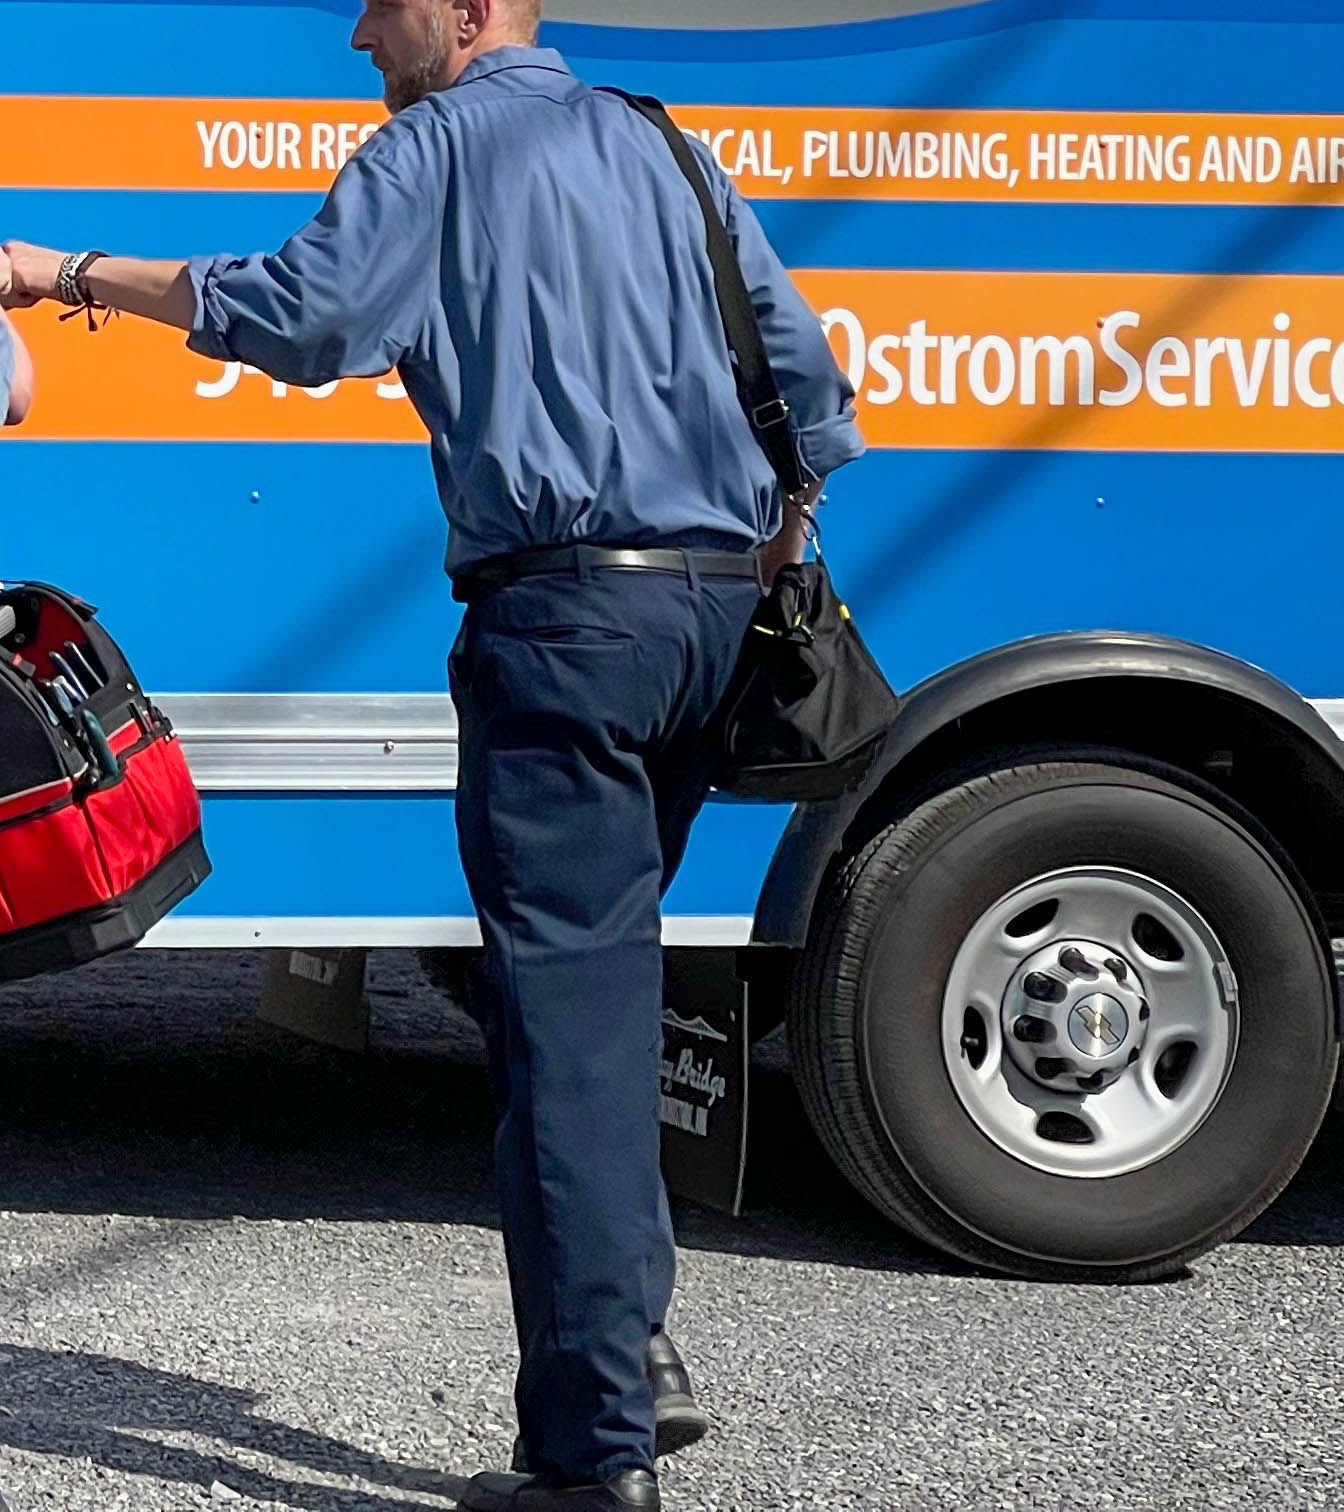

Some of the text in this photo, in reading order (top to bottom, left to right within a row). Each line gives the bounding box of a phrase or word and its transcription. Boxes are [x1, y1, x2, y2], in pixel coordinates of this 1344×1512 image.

[195, 120, 302, 170] YOUR
[679, 128, 795, 186] CAL,
[803, 129, 1020, 189] PLUMBING,
[1029, 133, 1191, 182] HEATING
[1198, 135, 1282, 183] AND
